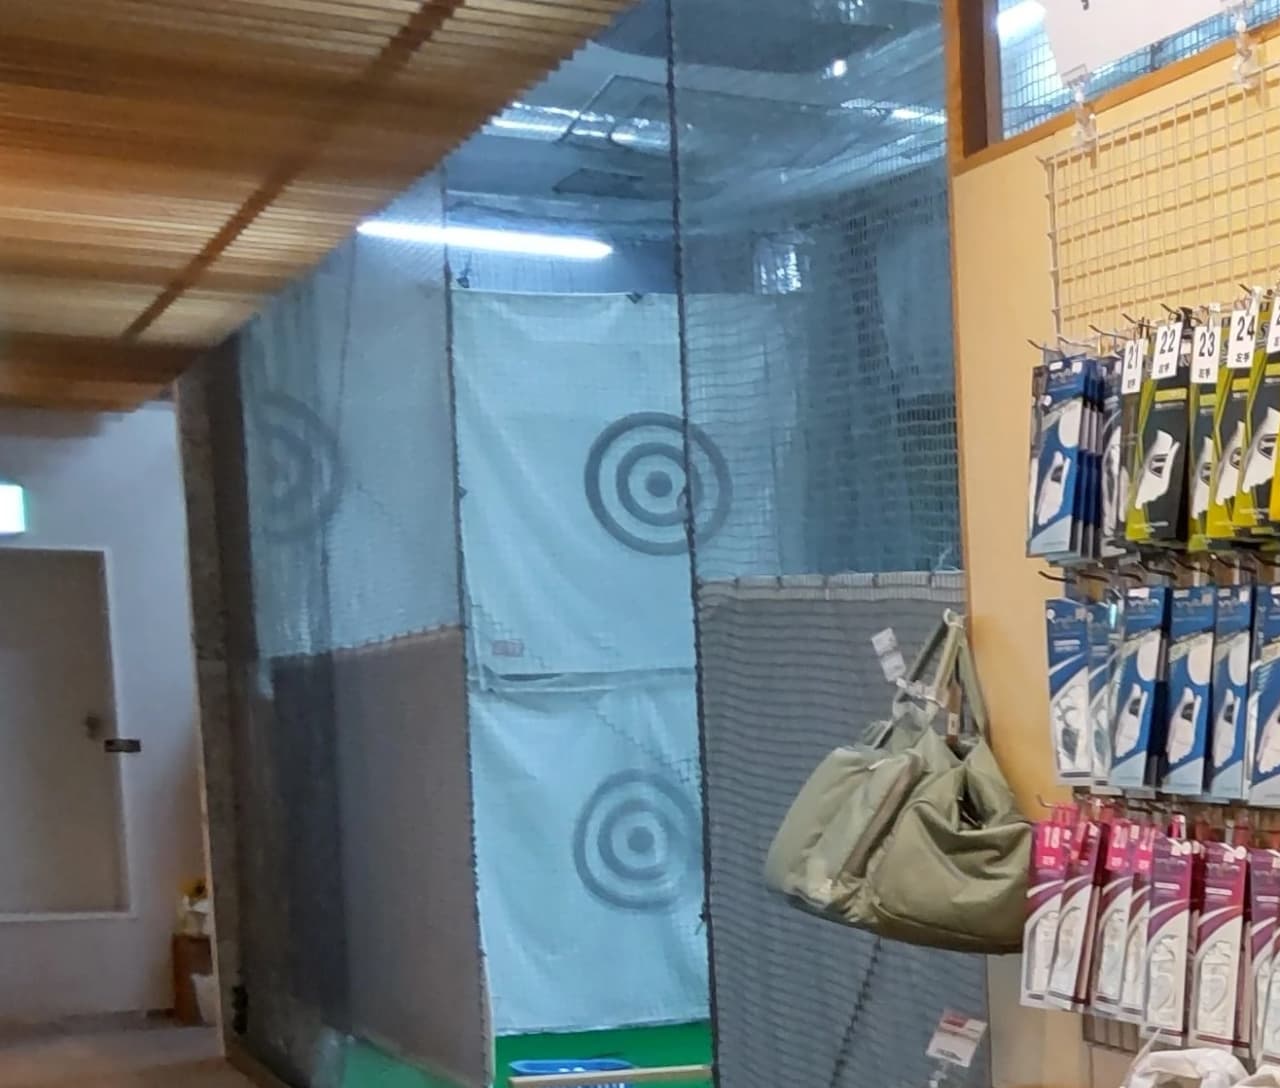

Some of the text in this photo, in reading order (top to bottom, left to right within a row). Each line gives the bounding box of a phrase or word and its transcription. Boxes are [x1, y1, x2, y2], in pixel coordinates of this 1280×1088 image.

[1158, 328, 1178, 355] 22
[1236, 315, 1256, 342] 24
[1127, 342, 1139, 370] 21
[1198, 333, 1216, 358] 23
